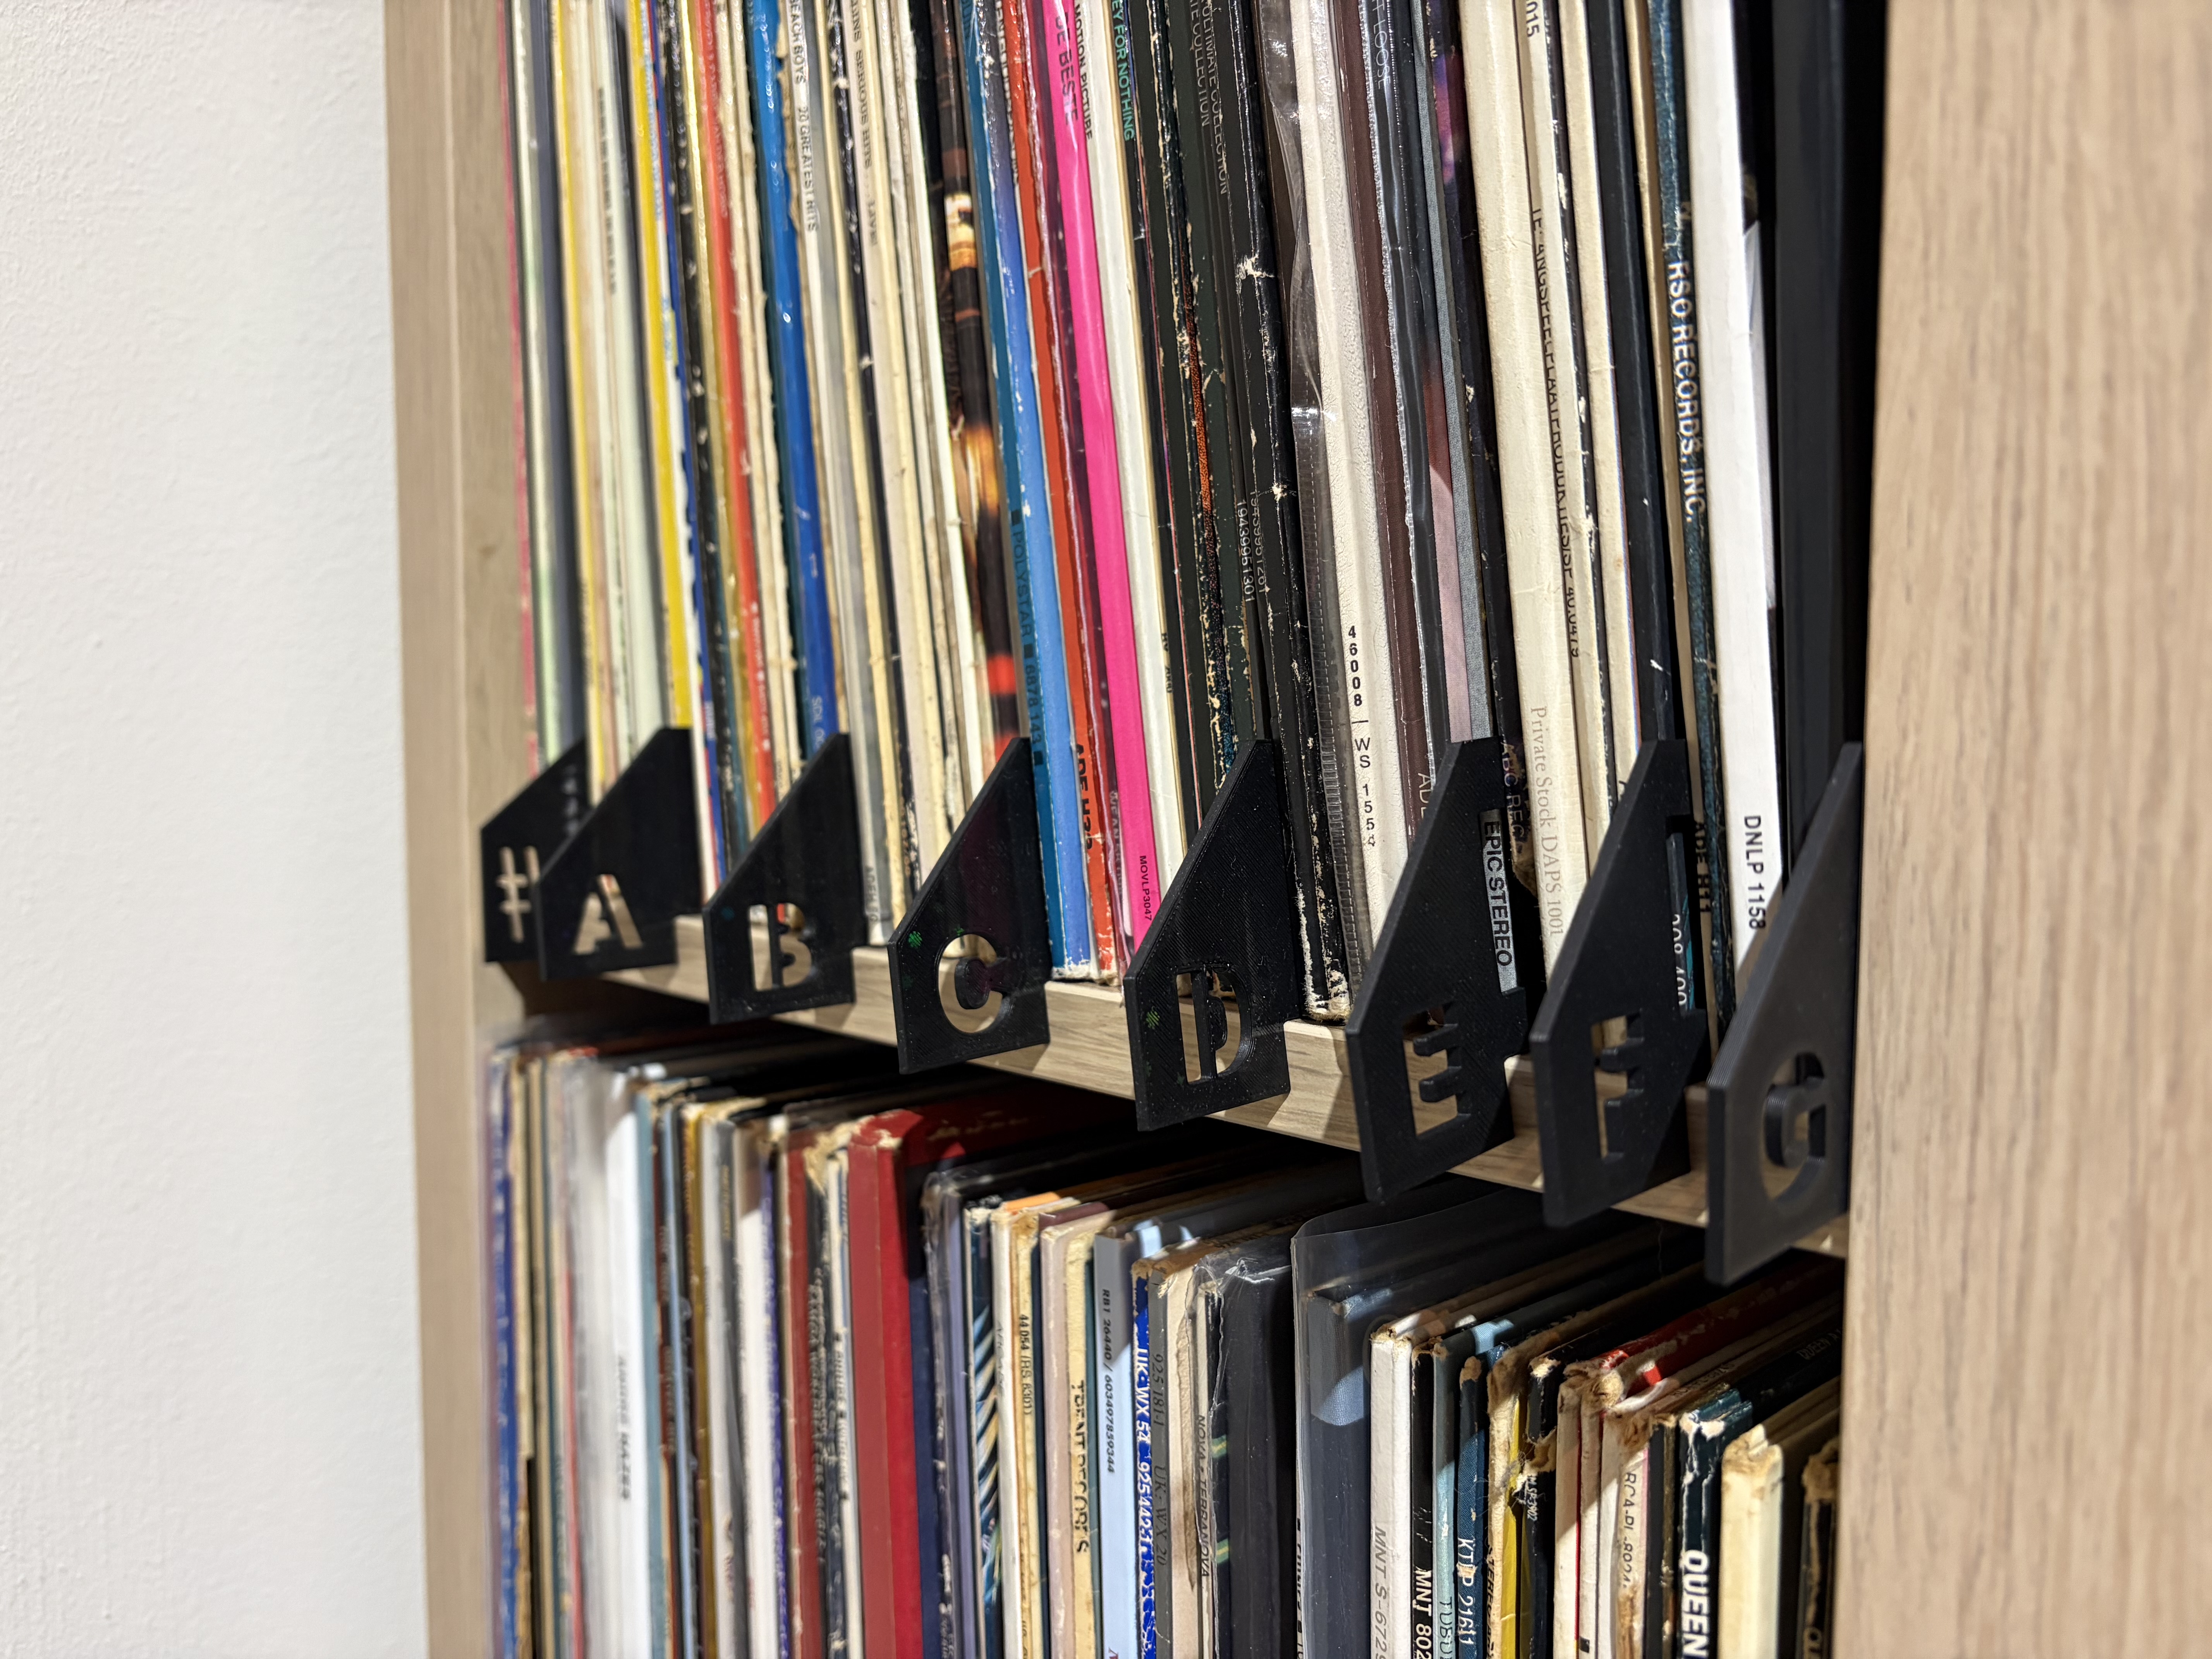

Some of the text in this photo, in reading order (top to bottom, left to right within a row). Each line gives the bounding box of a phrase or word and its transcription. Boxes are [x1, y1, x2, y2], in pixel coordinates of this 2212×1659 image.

[793, 45, 806, 84] BOYS
[1114, 25, 1127, 60] FOR
[1373, 19, 1391, 89] LOOSE
[1117, 62, 1135, 141] NOTHING
[799, 125, 814, 196] GREATEST
[1668, 261, 1693, 318] RSO
[1681, 467, 1706, 522] INC.
[1237, 499, 1255, 602] 19439951301
[1012, 531, 1033, 638] POLYSTAR
[1030, 714, 1042, 745] 143
[1348, 625, 1363, 706] 46008
[1355, 737, 1370, 769] WS
[1531, 706, 1564, 936] Private Stock DAPS 1001
[1140, 855, 1152, 921] MOVLP3047
[1484, 821, 1512, 966] EPIC STEREO
[1744, 815, 1766, 930] DNLP 1158
[573, 874, 644, 955] A
[748, 902, 812, 992] B
[938, 933, 1008, 1033] C
[1176, 963, 1252, 1083] D
[1401, 1001, 1472, 1140] E
[1761, 1052, 1827, 1201] G
[1103, 1319, 1113, 1361] 26440
[1104, 1374, 1115, 1474] 603497859344
[1136, 1387, 1149, 1417] WX
[1137, 1420, 1150, 1443] 54
[1153, 1353, 1168, 1566] 925 181-1 UK: WX 20
[1375, 1526, 1386, 1578] MNT
[1415, 1570, 1432, 1617] MNT
[1439, 1596, 1453, 1659] TUBU
[1458, 1594, 1474, 1644] 2161
[1678, 1549, 1710, 1659] QUEEN
